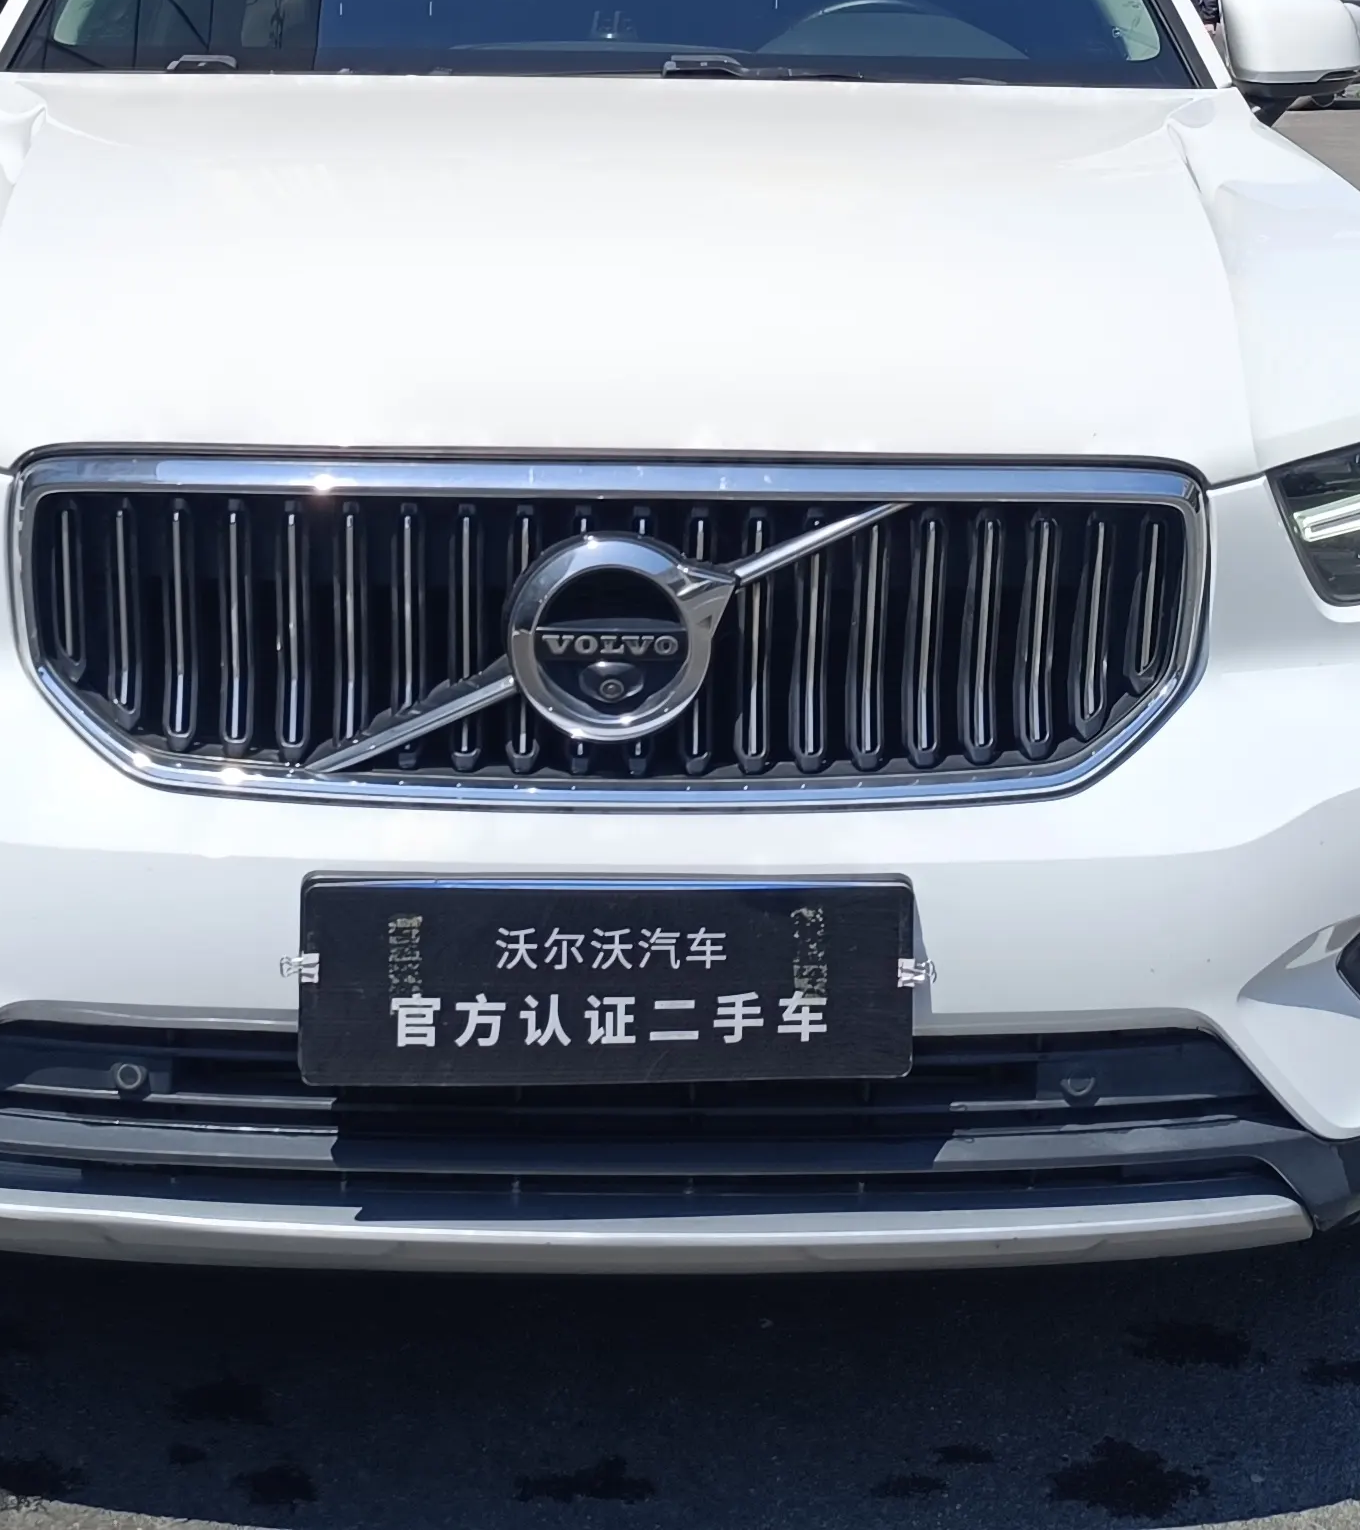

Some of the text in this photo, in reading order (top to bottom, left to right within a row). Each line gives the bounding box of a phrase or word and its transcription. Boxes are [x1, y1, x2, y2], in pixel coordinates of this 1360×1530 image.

[541, 634, 679, 656] VOLVO
[495, 926, 728, 971] 沃尔沃汽车
[389, 990, 829, 1048] 官方认证二手车
